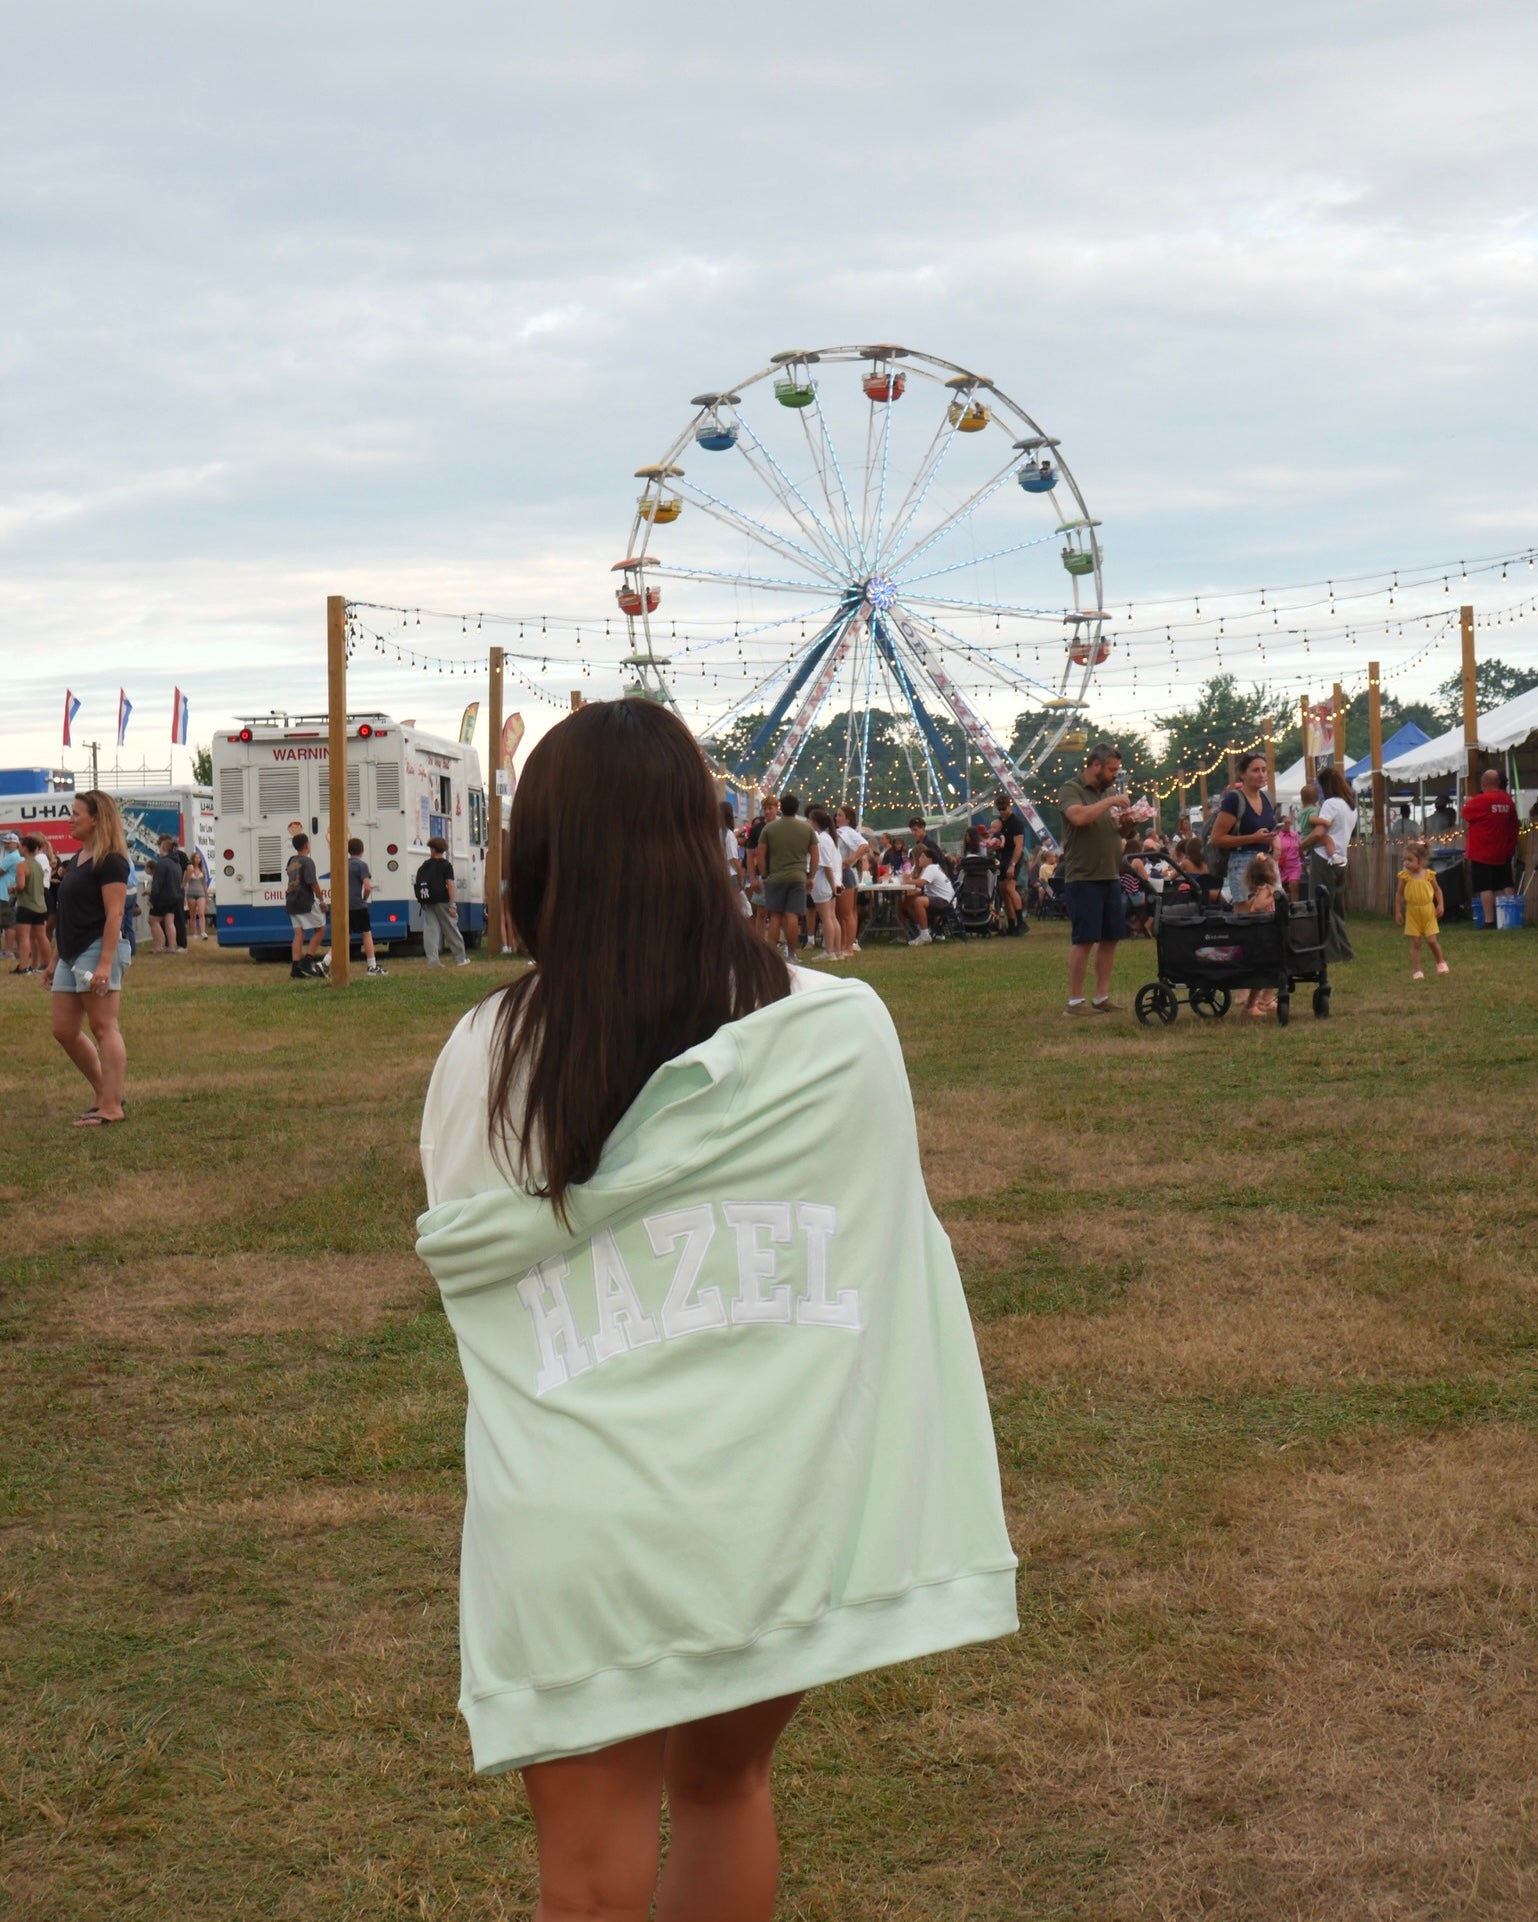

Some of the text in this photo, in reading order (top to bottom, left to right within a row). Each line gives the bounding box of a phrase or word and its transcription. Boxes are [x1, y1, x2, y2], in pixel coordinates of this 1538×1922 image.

[273, 747, 330, 761] WARNIN
[931, 671, 1037, 821] AMERICA
[21, 804, 71, 819] U-HA
[516, 1200, 863, 1397] HAZEL
